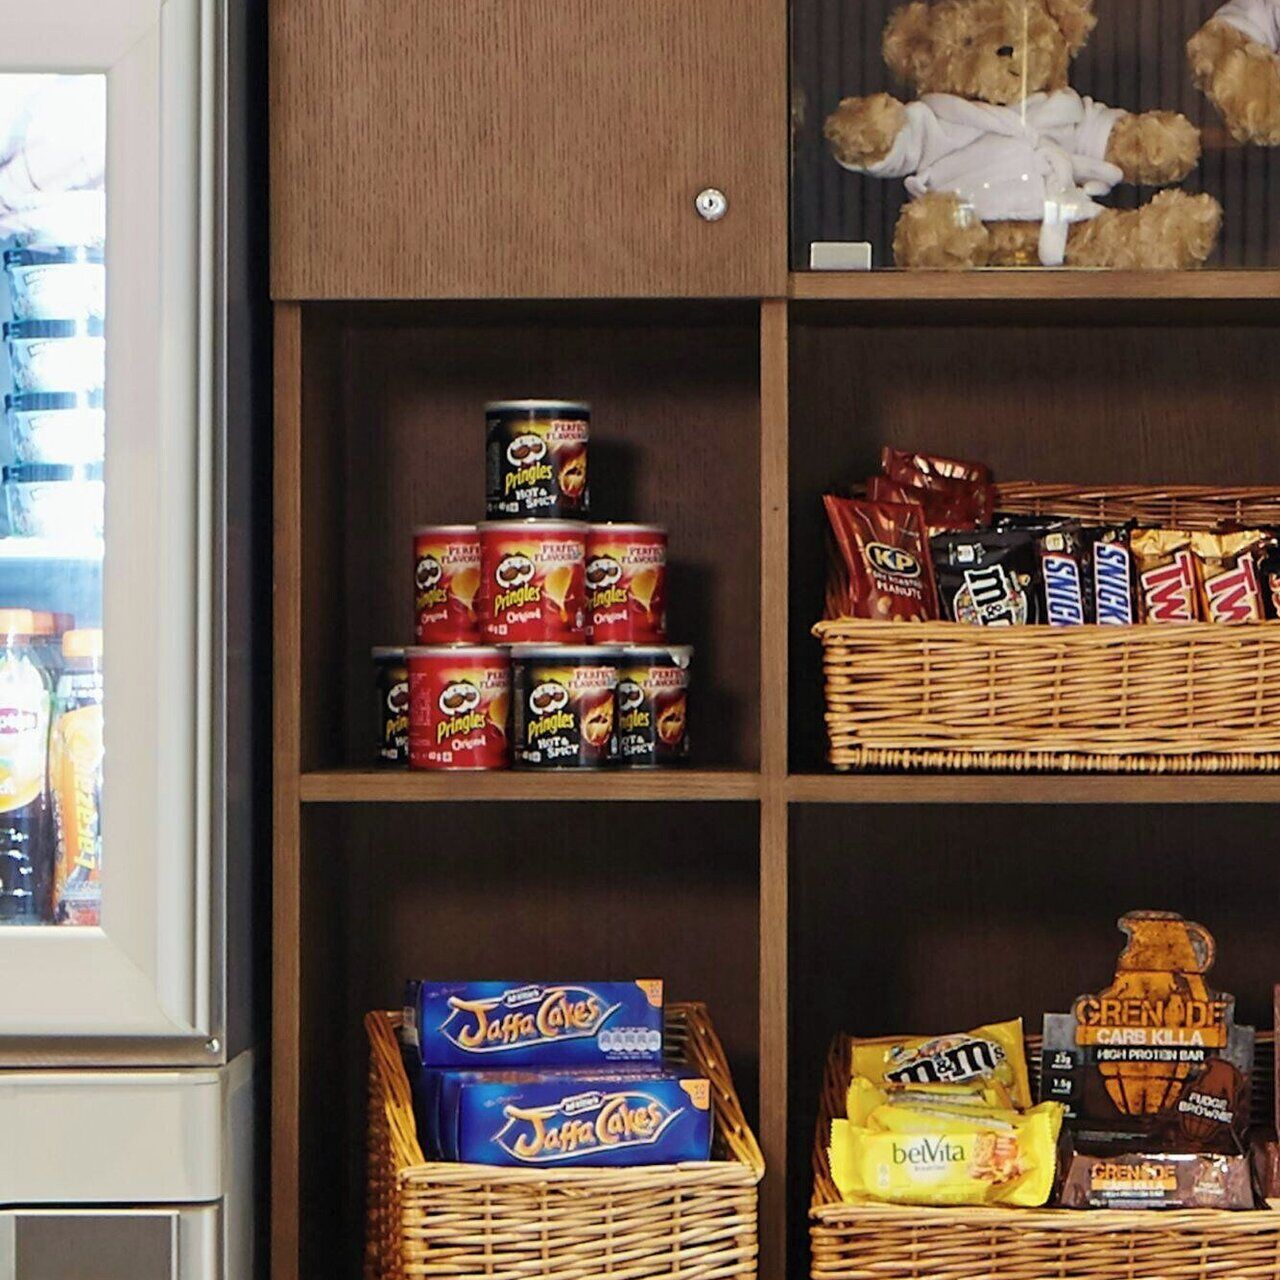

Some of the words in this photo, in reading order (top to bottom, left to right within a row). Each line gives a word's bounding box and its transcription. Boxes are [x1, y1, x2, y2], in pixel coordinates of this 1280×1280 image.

[505, 462, 553, 496] Pringles
[874, 548, 914, 570] KP
[494, 586, 541, 617] Pringles
[876, 579, 922, 600] PEANUTS
[438, 710, 486, 744] Pringles
[528, 710, 575, 744] Pringles
[547, 743, 579, 759] SPICY
[447, 995, 535, 1047] Jaffa
[537, 990, 600, 1038] Cakes
[1096, 1027, 1147, 1047] CARB
[1151, 1027, 1205, 1047] KILLA
[1096, 1048, 1127, 1062] HIGH
[1128, 1048, 1177, 1062] PROTEIN
[1179, 1049, 1205, 1062] BAR
[503, 1104, 595, 1157] Jaffa
[595, 1096, 662, 1145] Cakes
